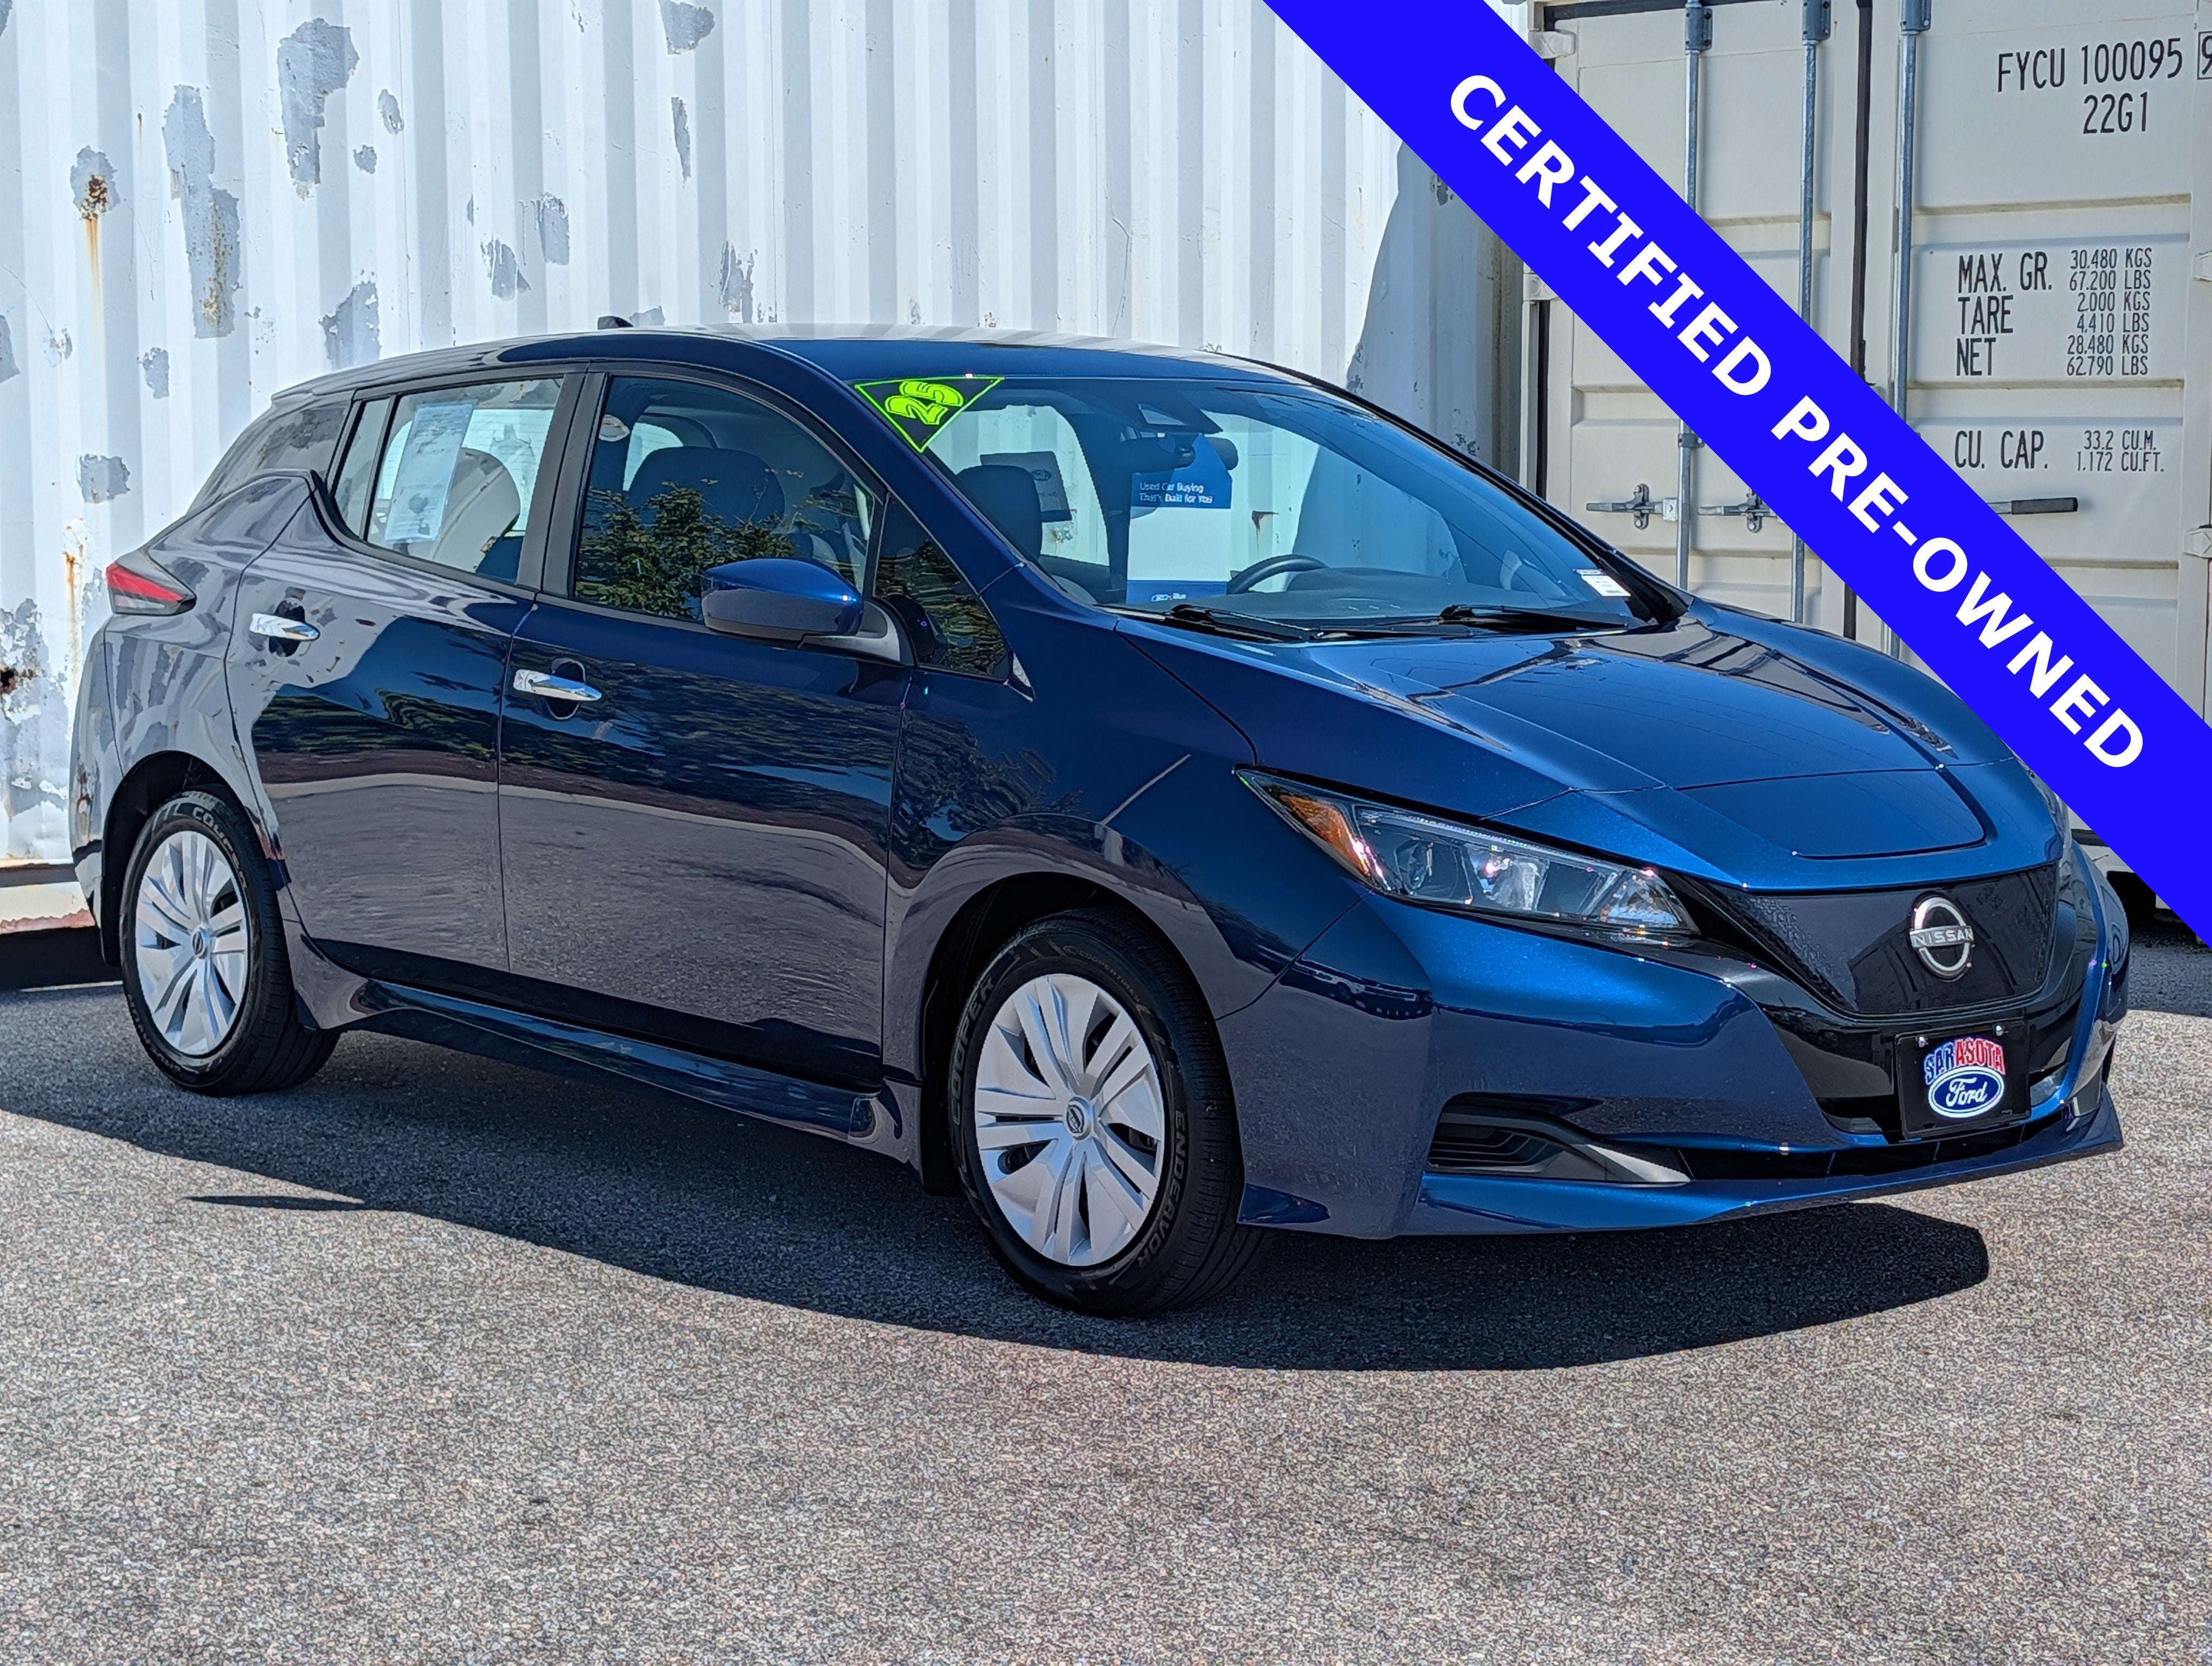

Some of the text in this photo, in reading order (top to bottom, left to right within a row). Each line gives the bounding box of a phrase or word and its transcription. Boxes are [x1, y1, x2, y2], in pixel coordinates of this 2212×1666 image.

[1998, 48, 2065, 93] FYCU
[2081, 37, 2183, 85] 100095
[2083, 91, 2147, 134] 22G1
[1958, 247, 2152, 293] MAX. GR. 30.480 KGS
[2069, 269, 2151, 291] 67.200 LBS
[1958, 294, 2014, 335] TARE
[2124, 291, 2151, 311] KGS
[2076, 312, 2150, 334] 4.410 LBS
[1956, 334, 2149, 376] NET 28.480 KGS
[2121, 355, 2148, 376] LBS
[1954, 430, 1985, 469] CU.
[2001, 430, 2048, 469] CAP.
[2084, 430, 2114, 451] 33.2
[2077, 451, 2113, 472] 1.172
[1140, 482, 1204, 493] Used Car Buying
[1185, 494, 1196, 503] for
[1912, 927, 1974, 947] NISSAN
[1924, 1037, 2005, 1085] SARASOTA
[1946, 1077, 1988, 1107] Ford
[1137, 1110, 1186, 1268] ENDEAVOR
